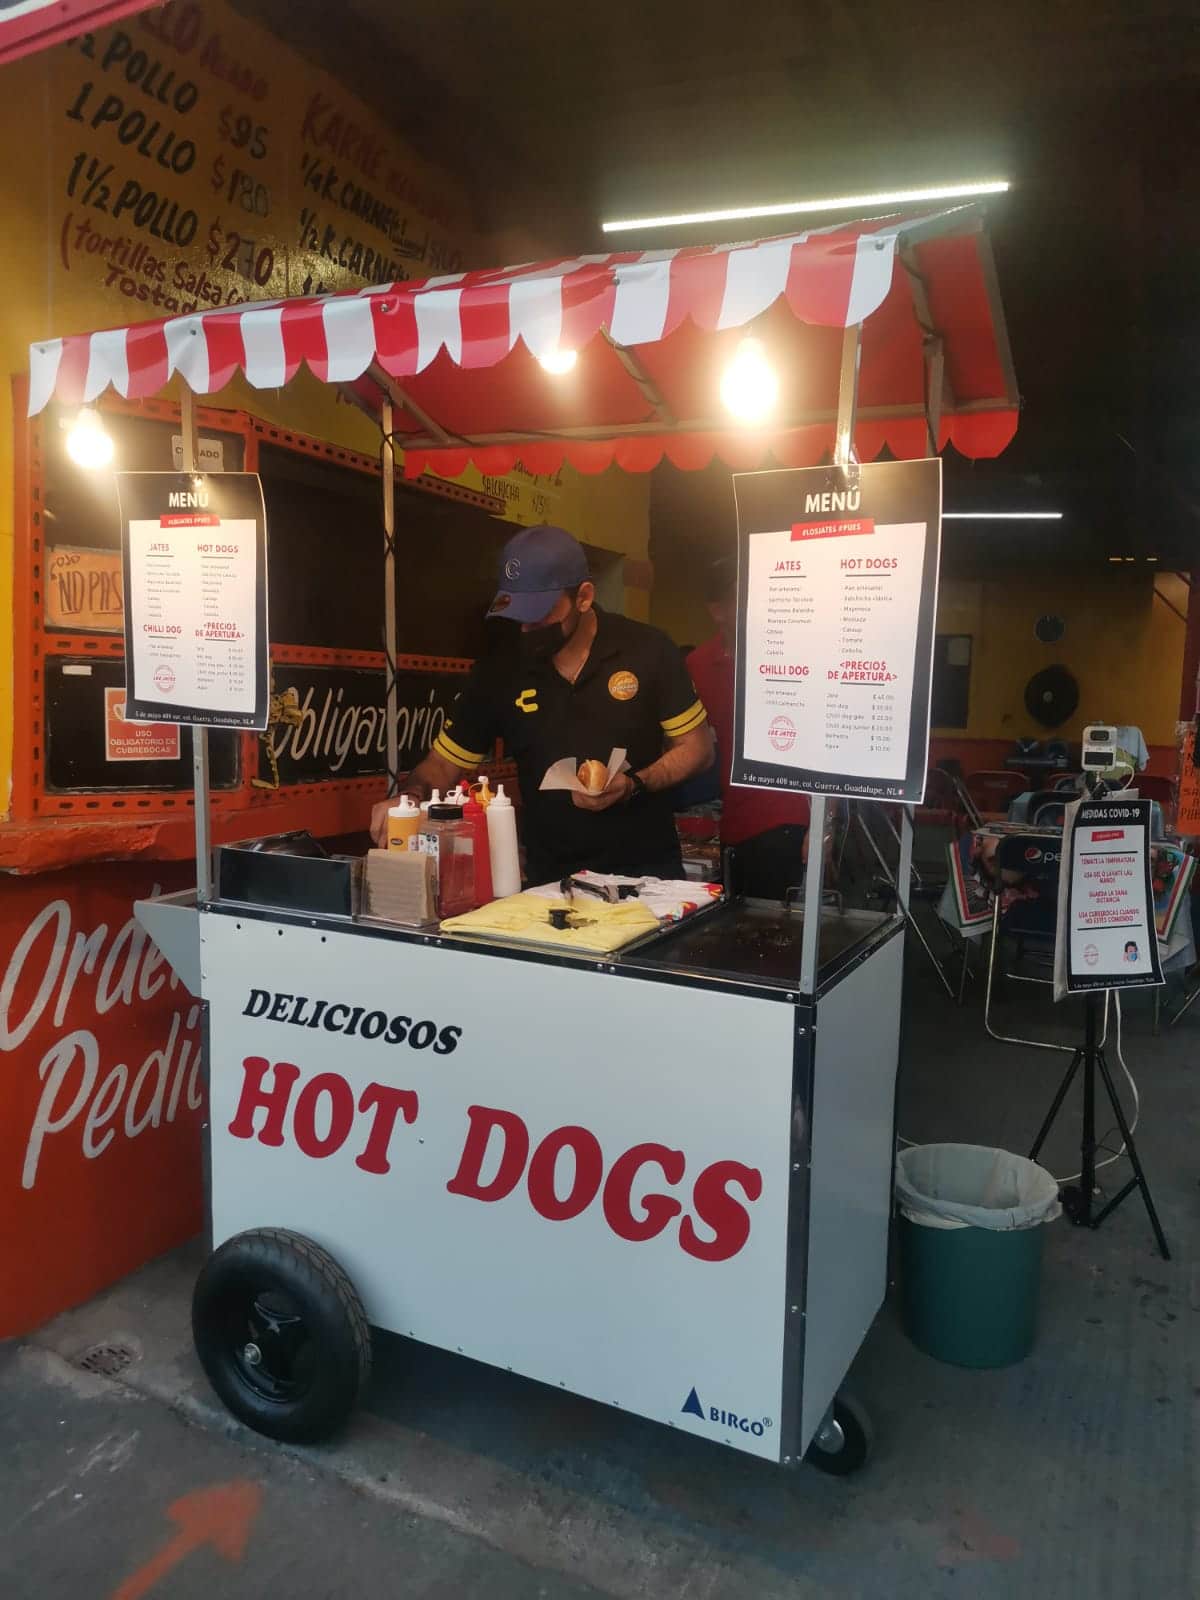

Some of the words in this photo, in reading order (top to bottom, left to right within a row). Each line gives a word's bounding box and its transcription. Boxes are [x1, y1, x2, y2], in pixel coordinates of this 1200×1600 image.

[102, 31, 198, 114] POLLO
[91, 95, 196, 174] POLLO
[112, 180, 198, 247] POLLO
[805, 485, 861, 513] MENÚ
[775, 560, 801, 571] JATES
[840, 559, 863, 570] HOT
[866, 558, 898, 569] DOGS
[759, 664, 786, 675] CHILLI
[789, 665, 810, 676] DOG
[827, 671, 839, 680] DE
[1109, 807, 1140, 818] COVID-19
[242, 988, 462, 1055] DELICIOSOS
[228, 1056, 419, 1175] HOT
[446, 1105, 763, 1262] DOGS
